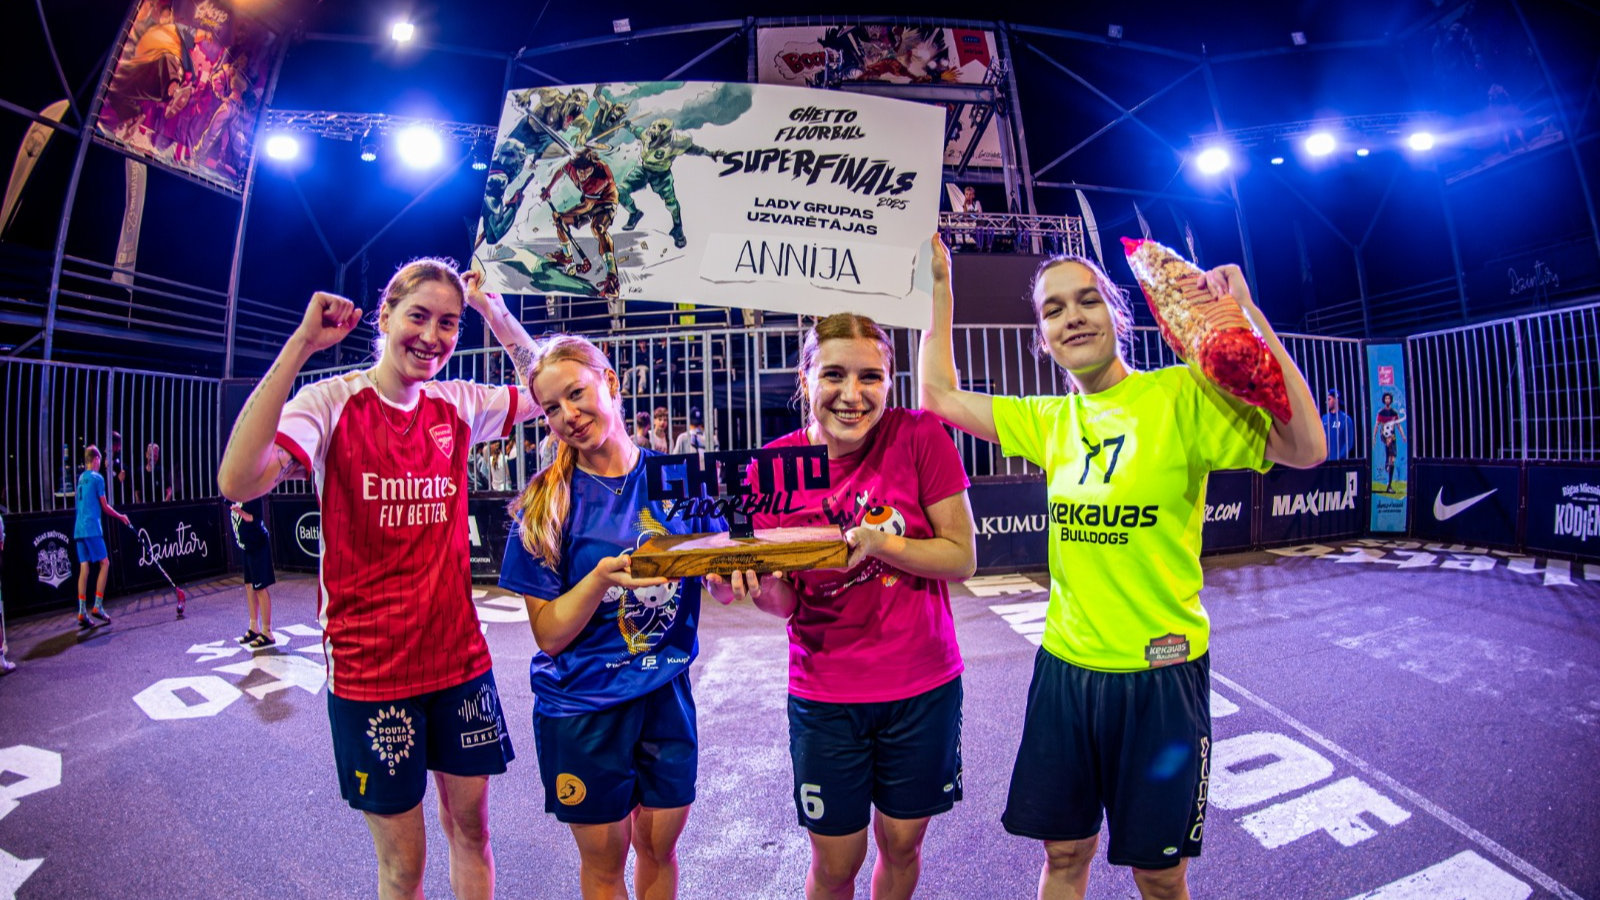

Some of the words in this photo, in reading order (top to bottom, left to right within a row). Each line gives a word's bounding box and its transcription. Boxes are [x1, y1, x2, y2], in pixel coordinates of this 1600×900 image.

[789, 105, 857, 124] GHETTO
[774, 125, 866, 142] FLOORBALL
[754, 197, 801, 211] LADY
[804, 202, 874, 220] GRUPAS
[876, 196, 910, 210] 2025
[747, 211, 878, 235] UZVARĒTĀJAS
[735, 240, 861, 285] ANNIJA
[646, 445, 830, 500] GHETTO
[362, 471, 457, 500] Emirates
[380, 504, 404, 527] FLY
[407, 502, 448, 526] BETTER
[666, 490, 806, 521] FLOORBALL
[1272, 488, 1356, 516] MAXIMA
[299, 526, 320, 540] Balti
[975, 514, 1049, 541] ĶUMU
[1554, 503, 1600, 541] KODIEN
[139, 521, 208, 567] Dzintars
[1061, 527, 1129, 545] BULLDOGS
[379, 726, 407, 735] POUTA
[380, 734, 407, 743] POLKU
[355, 770, 368, 795] 7
[800, 783, 825, 820] 6
